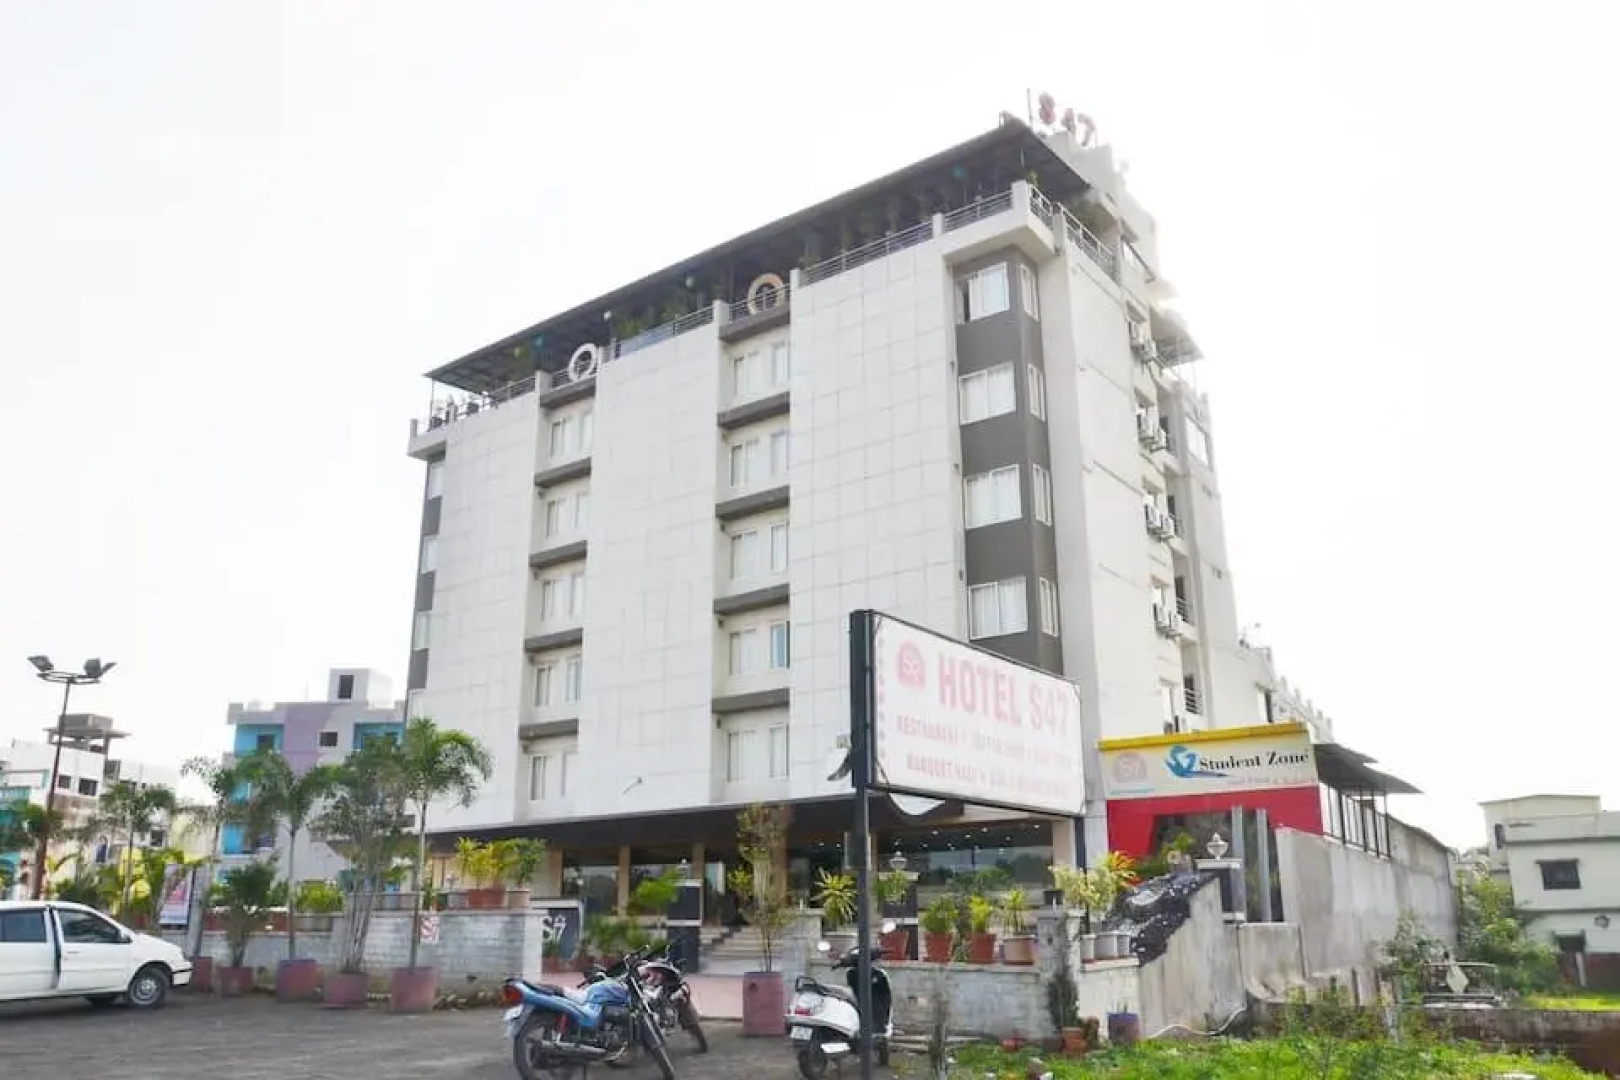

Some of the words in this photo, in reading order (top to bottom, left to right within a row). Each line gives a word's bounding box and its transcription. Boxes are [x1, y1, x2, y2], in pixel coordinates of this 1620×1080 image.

[939, 654, 1021, 726] HOTEL
[1028, 681, 1069, 738] S47
[1199, 755, 1261, 771] Student
[1266, 750, 1309, 766] Zone
